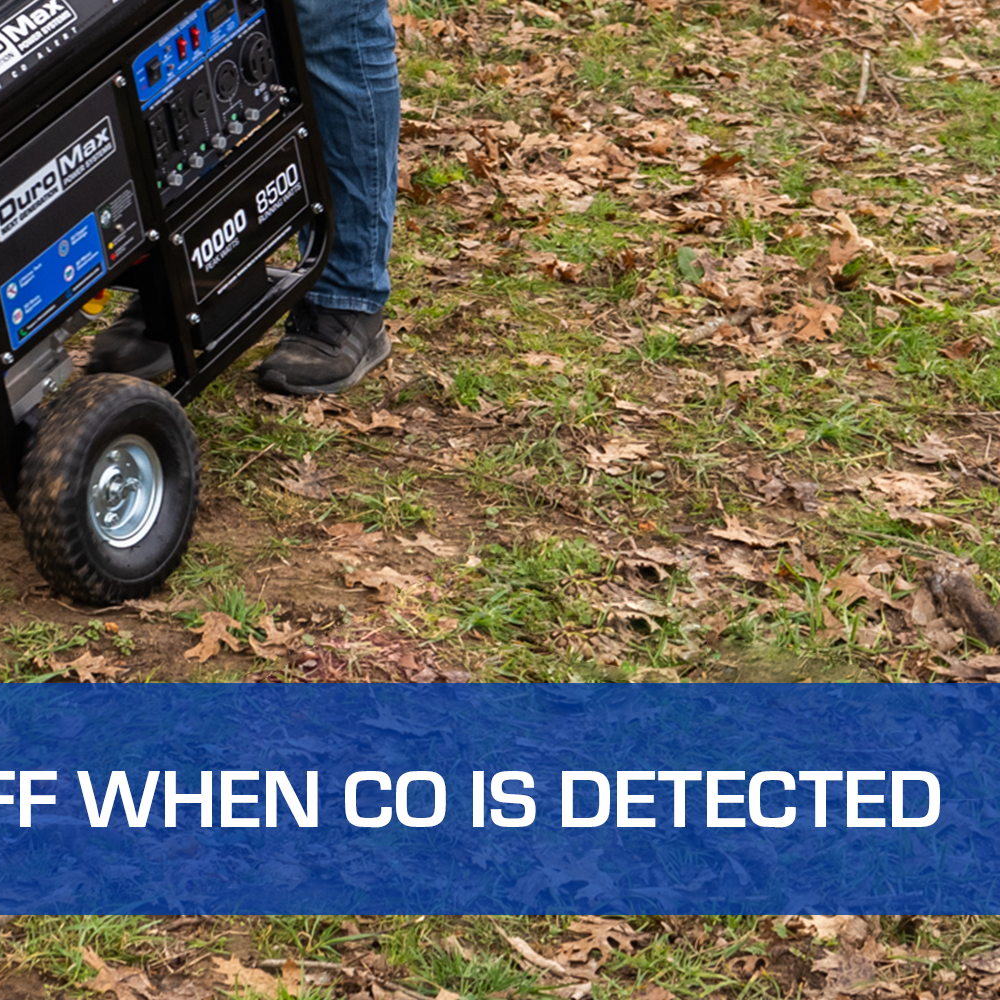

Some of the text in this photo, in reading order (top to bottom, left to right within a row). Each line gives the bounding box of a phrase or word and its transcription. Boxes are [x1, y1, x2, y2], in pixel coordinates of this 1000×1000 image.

[11, 63, 28, 79] CO
[36, 26, 78, 60] ALERT
[17, 10, 72, 52] POWER SYSTEMS
[63, 142, 113, 186] POWER SYSTEMS
[0, 186, 59, 236] NEXT GENERATION
[255, 163, 299, 214] 8500
[258, 181, 303, 225] RUNNING WATTS
[191, 208, 247, 269] 10000
[205, 237, 240, 272] PEAK WATTS
